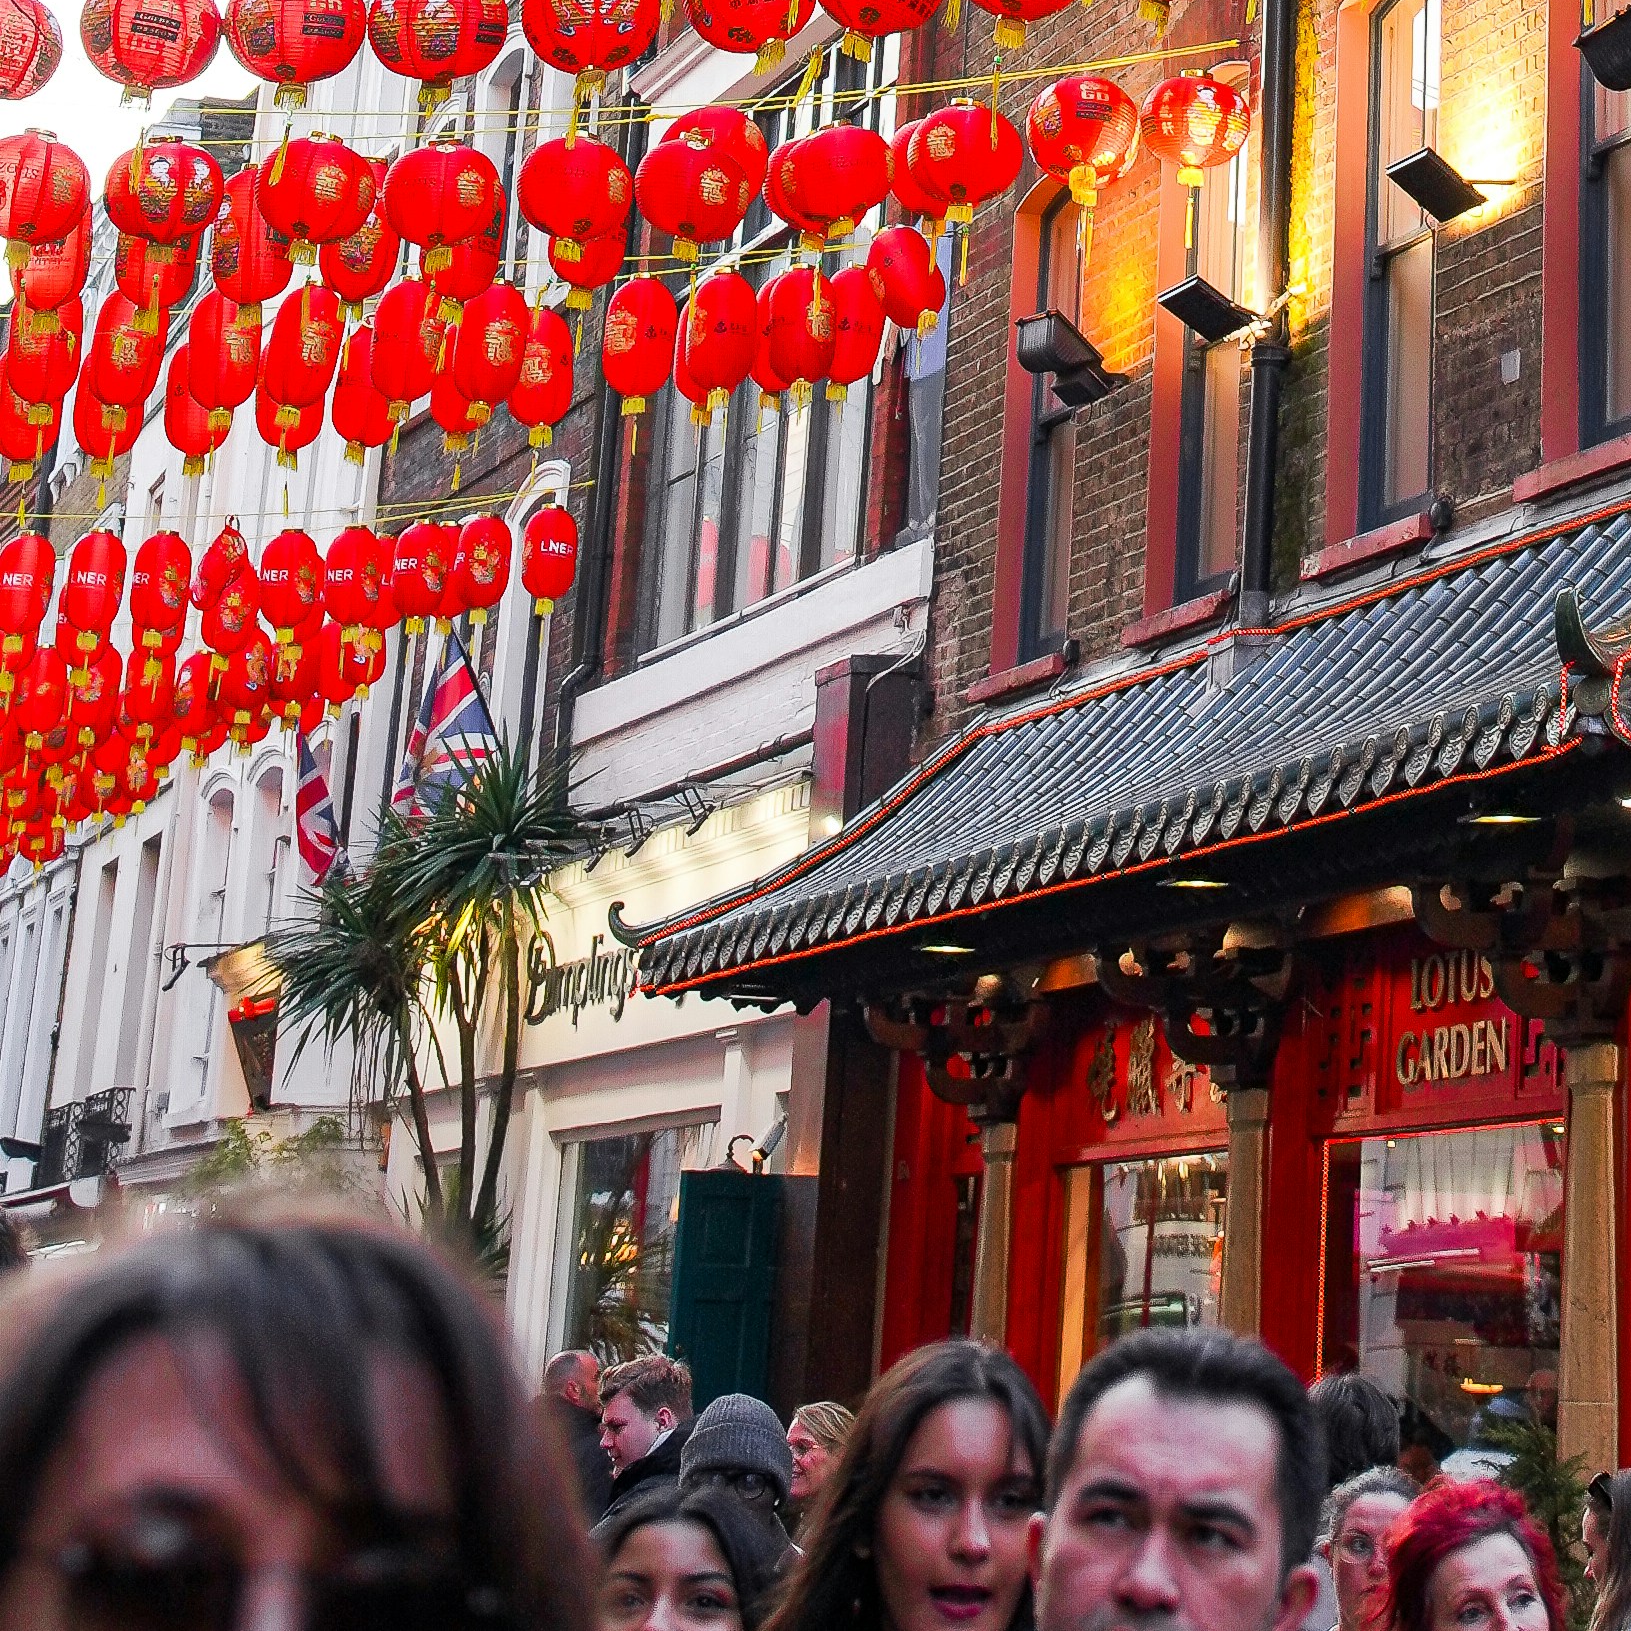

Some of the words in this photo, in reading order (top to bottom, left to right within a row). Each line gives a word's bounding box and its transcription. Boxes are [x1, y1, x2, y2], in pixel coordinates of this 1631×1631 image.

[394, 558, 417, 570] NER
[540, 538, 573, 554] LNER
[1410, 949, 1495, 1009] LOTUS
[1396, 1016, 1506, 1085] GARDEN
